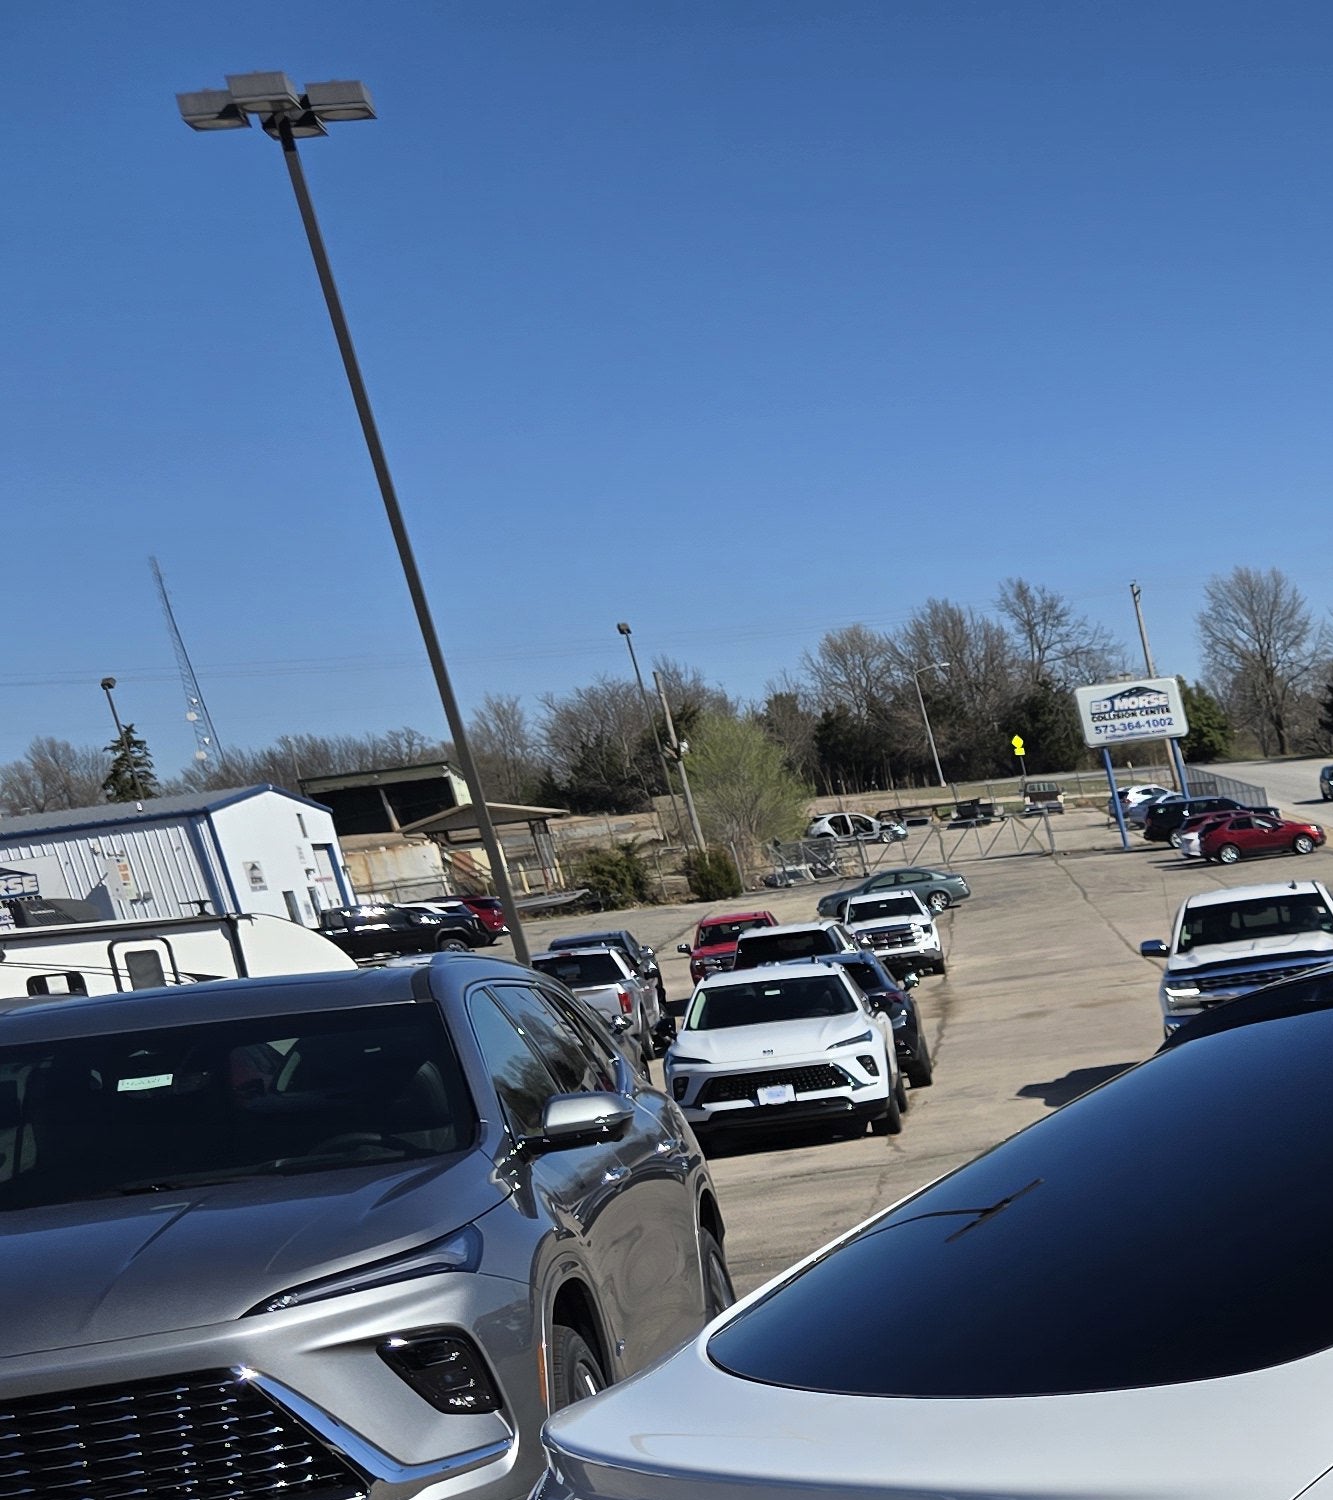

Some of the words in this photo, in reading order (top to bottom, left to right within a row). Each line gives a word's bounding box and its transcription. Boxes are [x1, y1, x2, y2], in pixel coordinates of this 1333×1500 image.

[1091, 701, 1113, 714] ED
[1114, 692, 1168, 711] MORSE
[1092, 711, 1137, 722] COLLISION
[1140, 706, 1171, 717] CENTER
